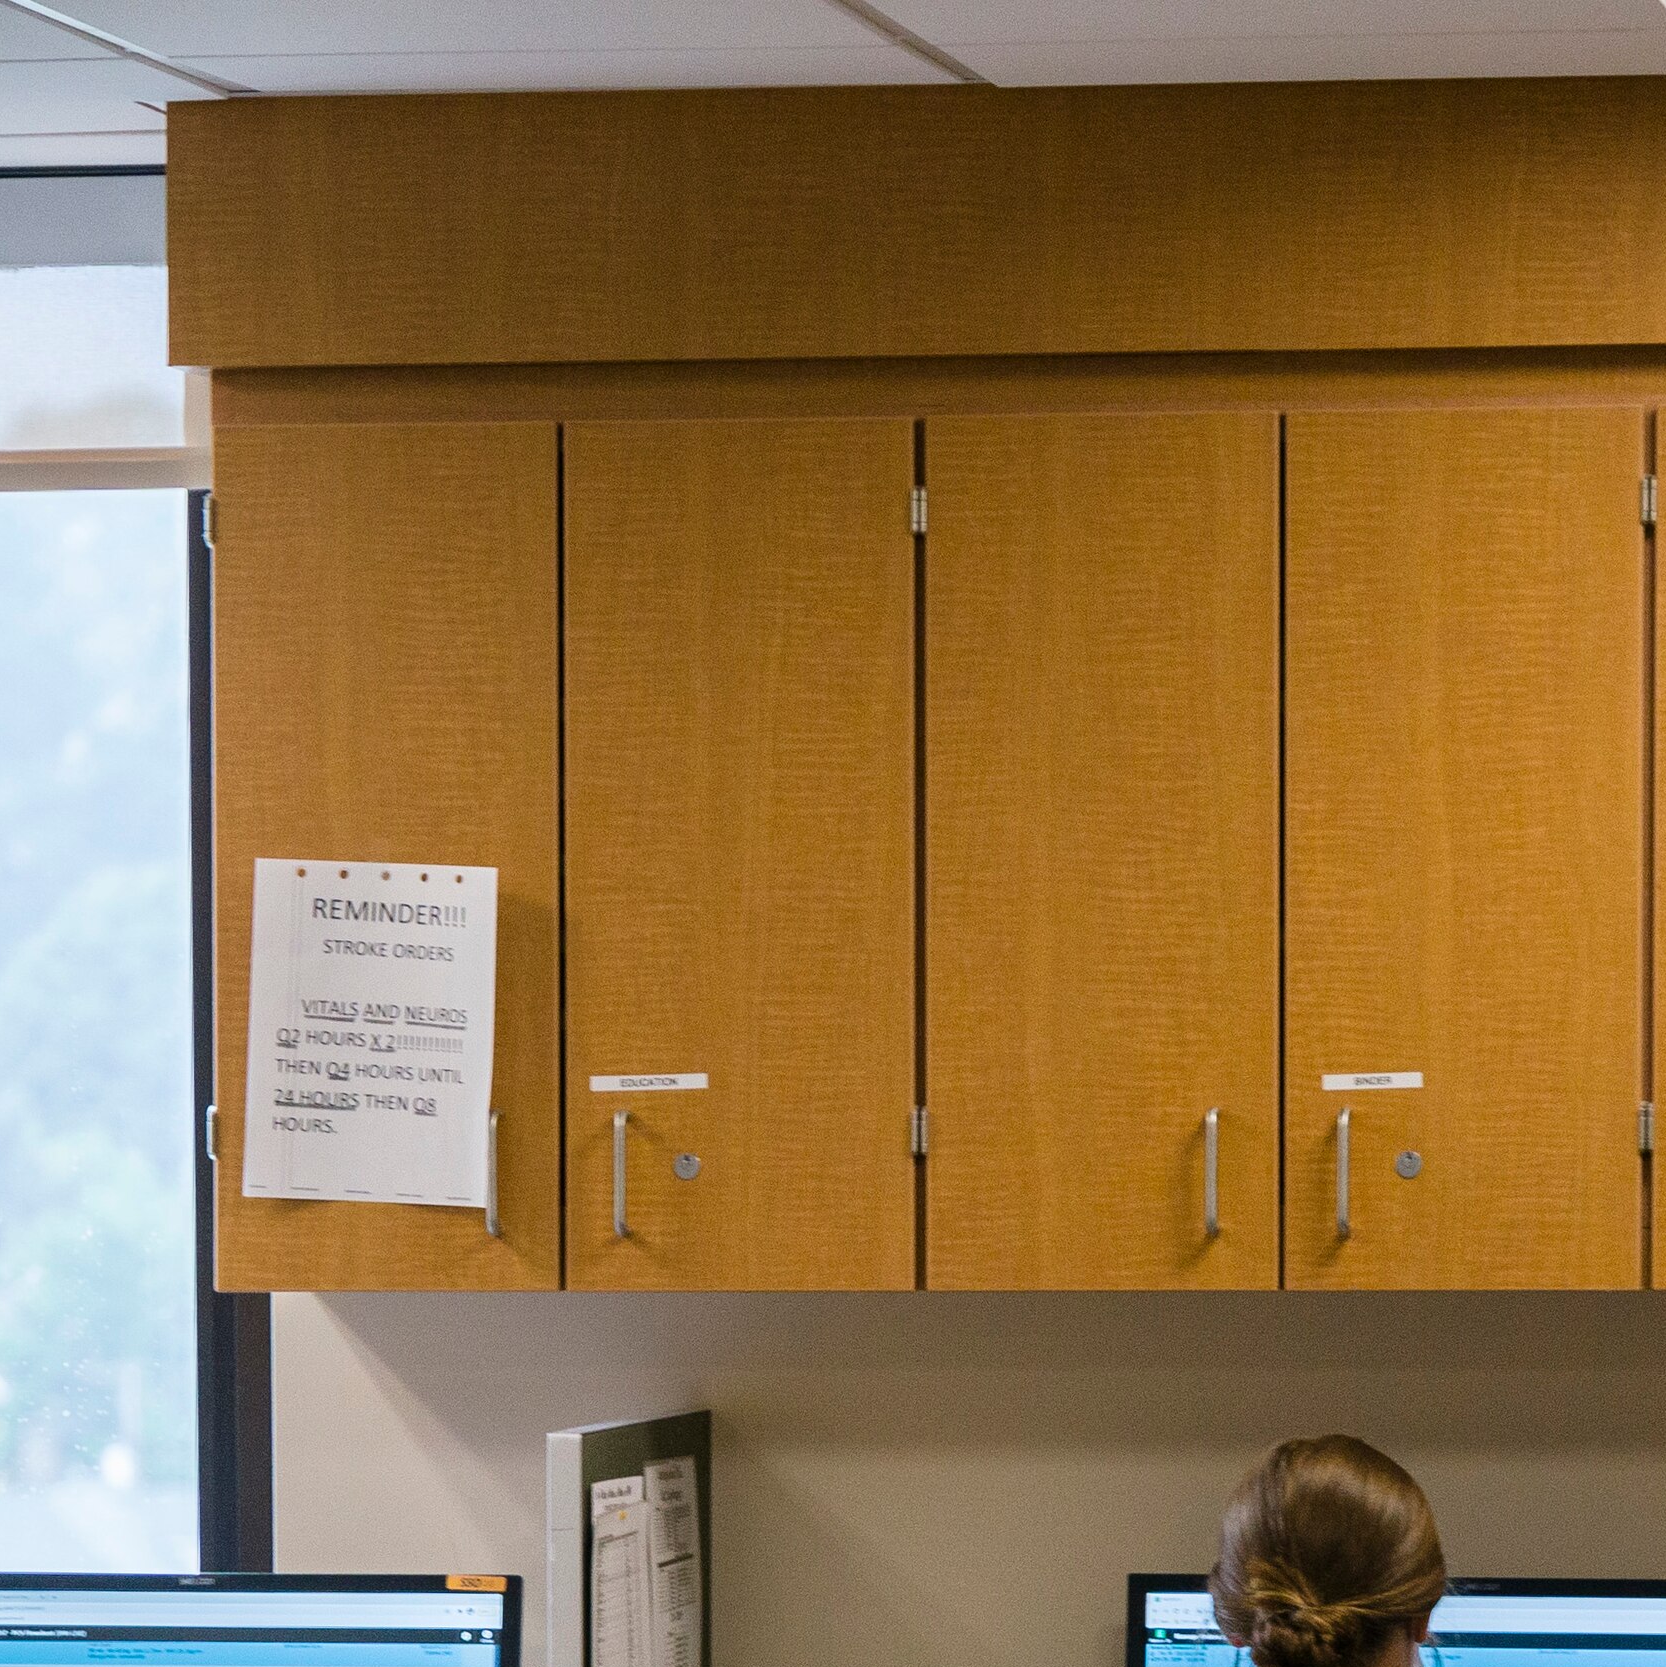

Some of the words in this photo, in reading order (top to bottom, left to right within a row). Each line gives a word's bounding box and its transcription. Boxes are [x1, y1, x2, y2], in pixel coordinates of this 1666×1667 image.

[312, 897, 467, 928] REMINDER!!!
[323, 939, 388, 957] STROKE
[392, 943, 455, 961] ORDERS
[301, 999, 359, 1018] VITALS
[364, 1003, 400, 1020] AND
[404, 1005, 468, 1025] NEUROS
[305, 1030, 366, 1047] HOURS
[275, 1058, 321, 1075] THEN
[355, 1064, 414, 1080] HOURS
[418, 1067, 465, 1084] UNTIL
[620, 1077, 678, 1087] EDUCATION
[299, 1090, 360, 1109] HOURS
[364, 1093, 409, 1111] THEN
[272, 1116, 337, 1134] HOURS.
